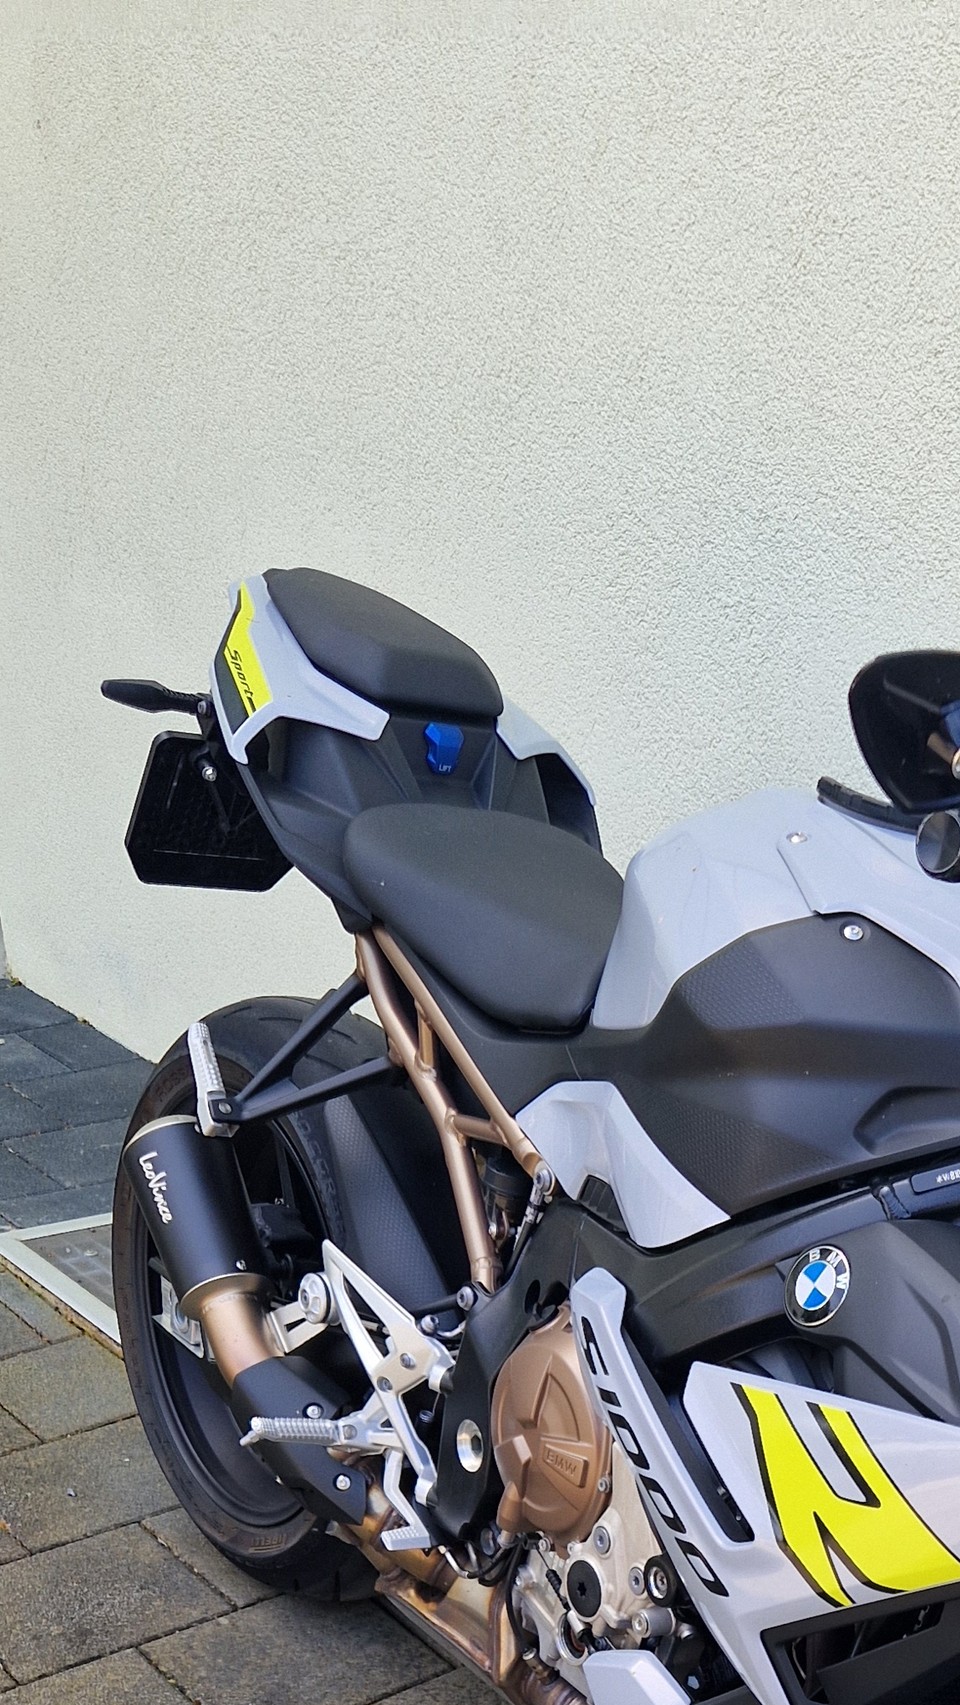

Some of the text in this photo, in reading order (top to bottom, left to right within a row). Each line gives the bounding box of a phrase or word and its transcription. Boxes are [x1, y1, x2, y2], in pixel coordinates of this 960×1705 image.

[226, 646, 254, 698] Sport
[138, 1151, 173, 1225] LeoVince
[808, 1248, 849, 1291] BMW
[545, 1450, 578, 1475] BMW
[581, 1315, 730, 1598] S1000
